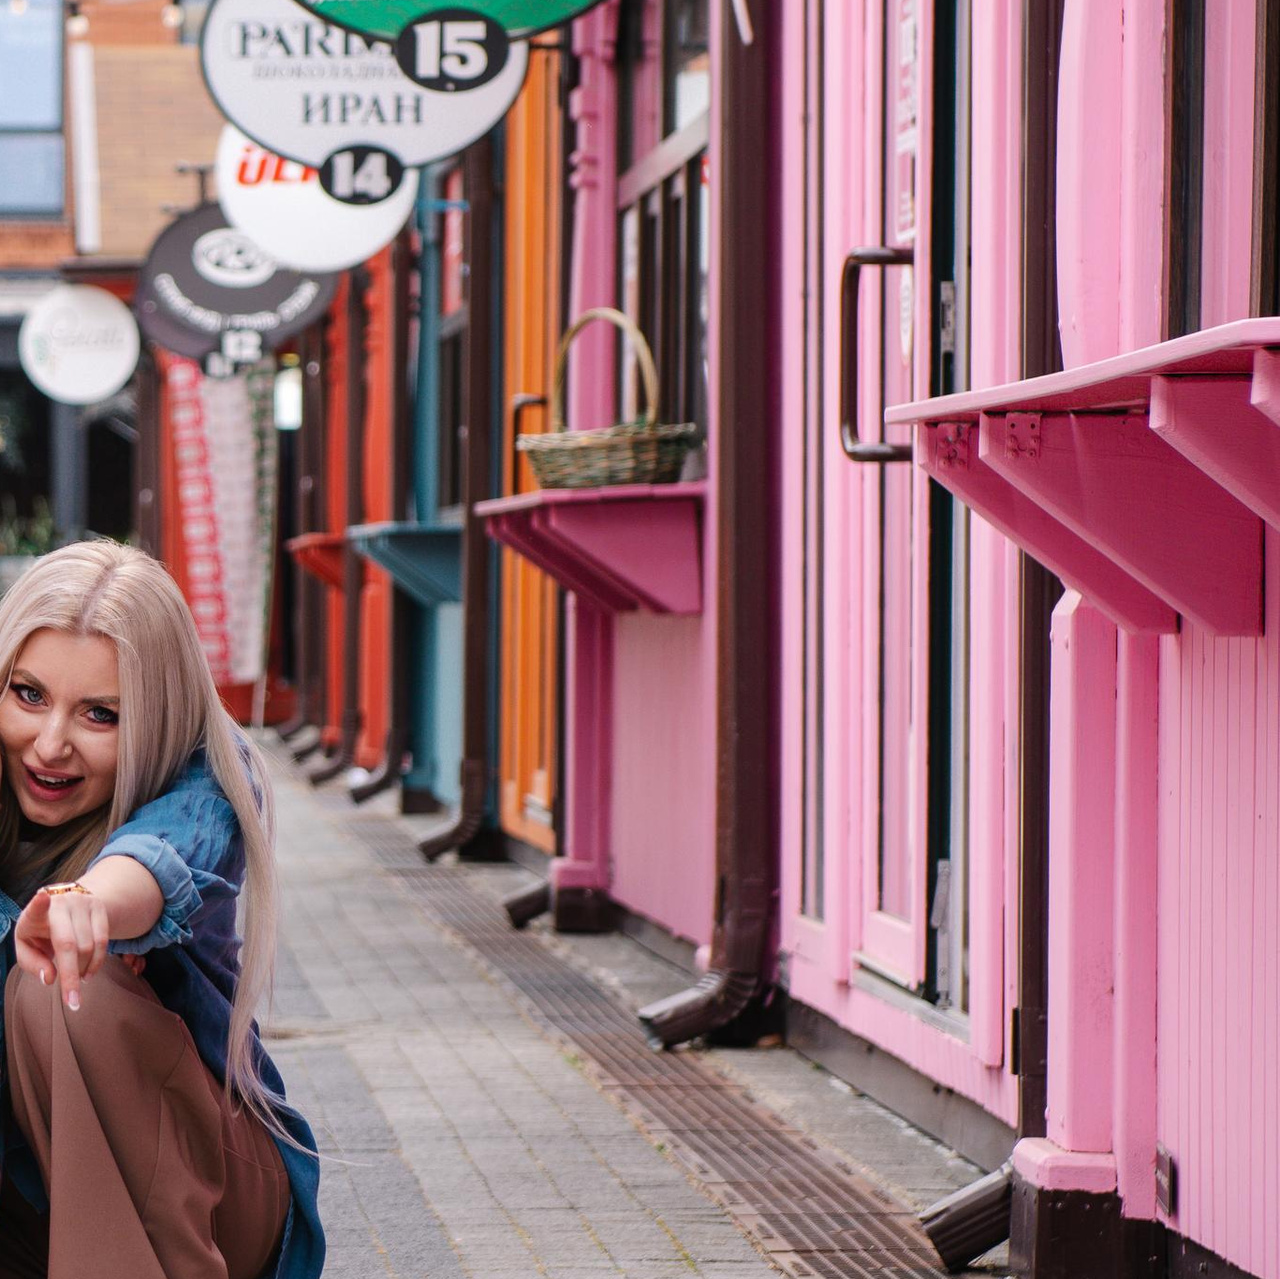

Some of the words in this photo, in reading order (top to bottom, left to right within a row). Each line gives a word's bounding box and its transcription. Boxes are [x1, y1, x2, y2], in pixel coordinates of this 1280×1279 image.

[414, 21, 488, 80] 15
[301, 93, 424, 125] ИРАН
[330, 152, 393, 198] 14
